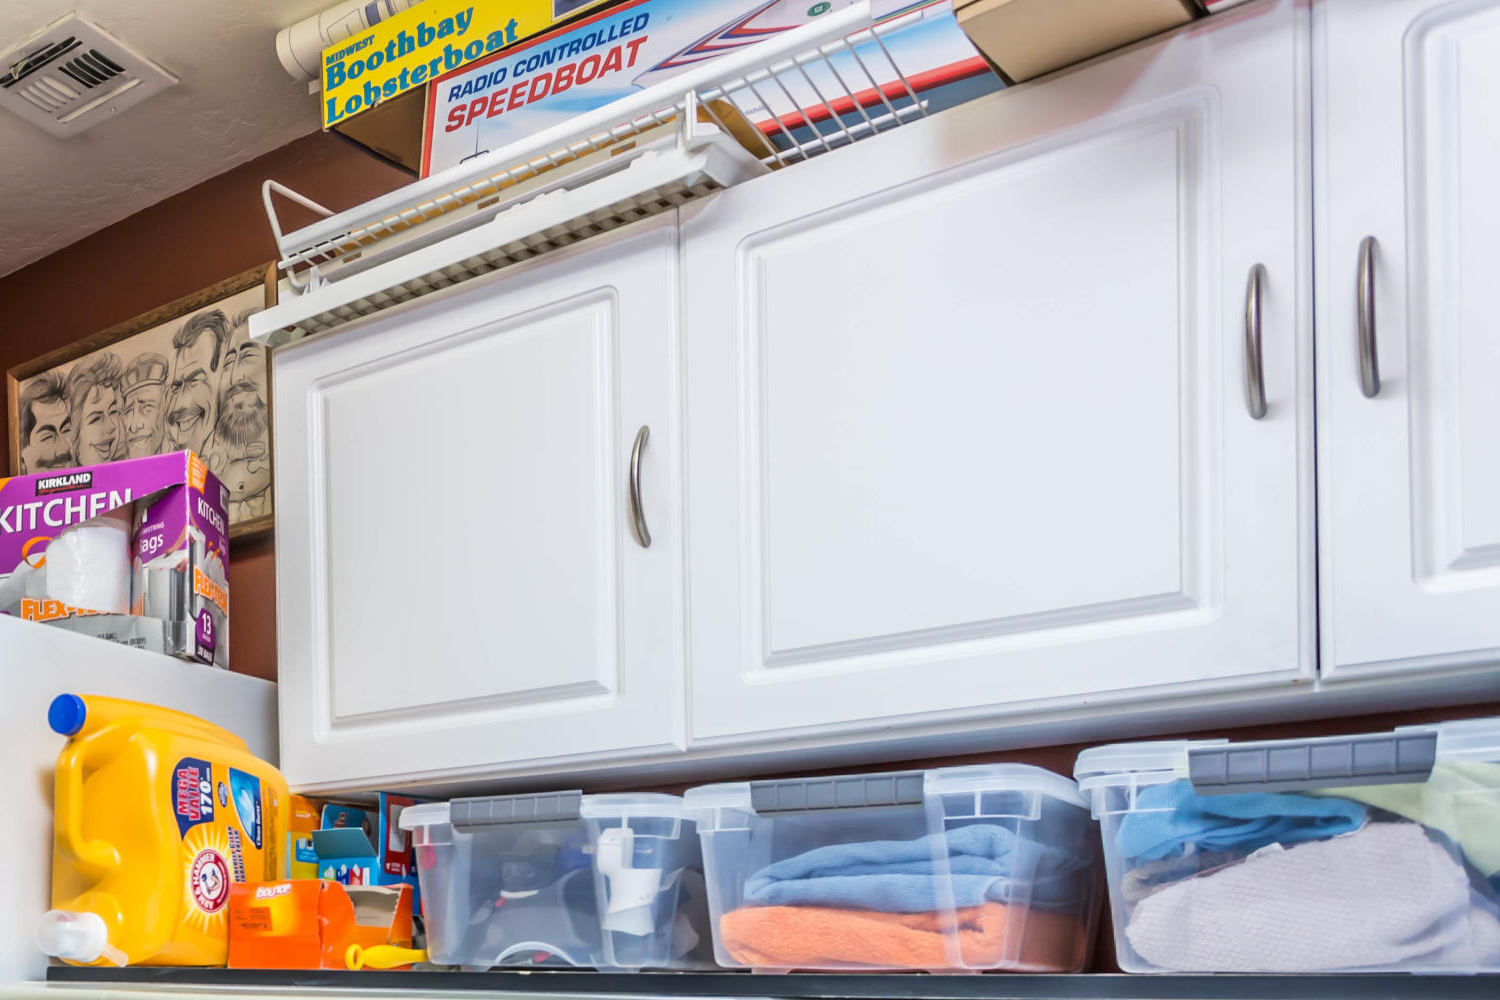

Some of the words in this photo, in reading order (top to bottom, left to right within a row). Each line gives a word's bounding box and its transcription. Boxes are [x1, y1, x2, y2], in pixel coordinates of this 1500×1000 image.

[326, 7, 474, 91] Boothbay
[326, 34, 375, 66] MIDWEST
[448, 68, 506, 103] RADIO
[512, 12, 650, 79] CONTROLLED
[326, 18, 519, 124] Lobsterboat
[445, 36, 648, 133] SPEEDBOAT
[38, 473, 91, 490] KIRKLAND
[198, 497, 225, 536] KITCHEN
[141, 534, 164, 554] ags
[201, 612, 212, 635] 13
[177, 769, 188, 815] MEGA
[188, 766, 201, 821] VALUE
[200, 780, 212, 815] 170
